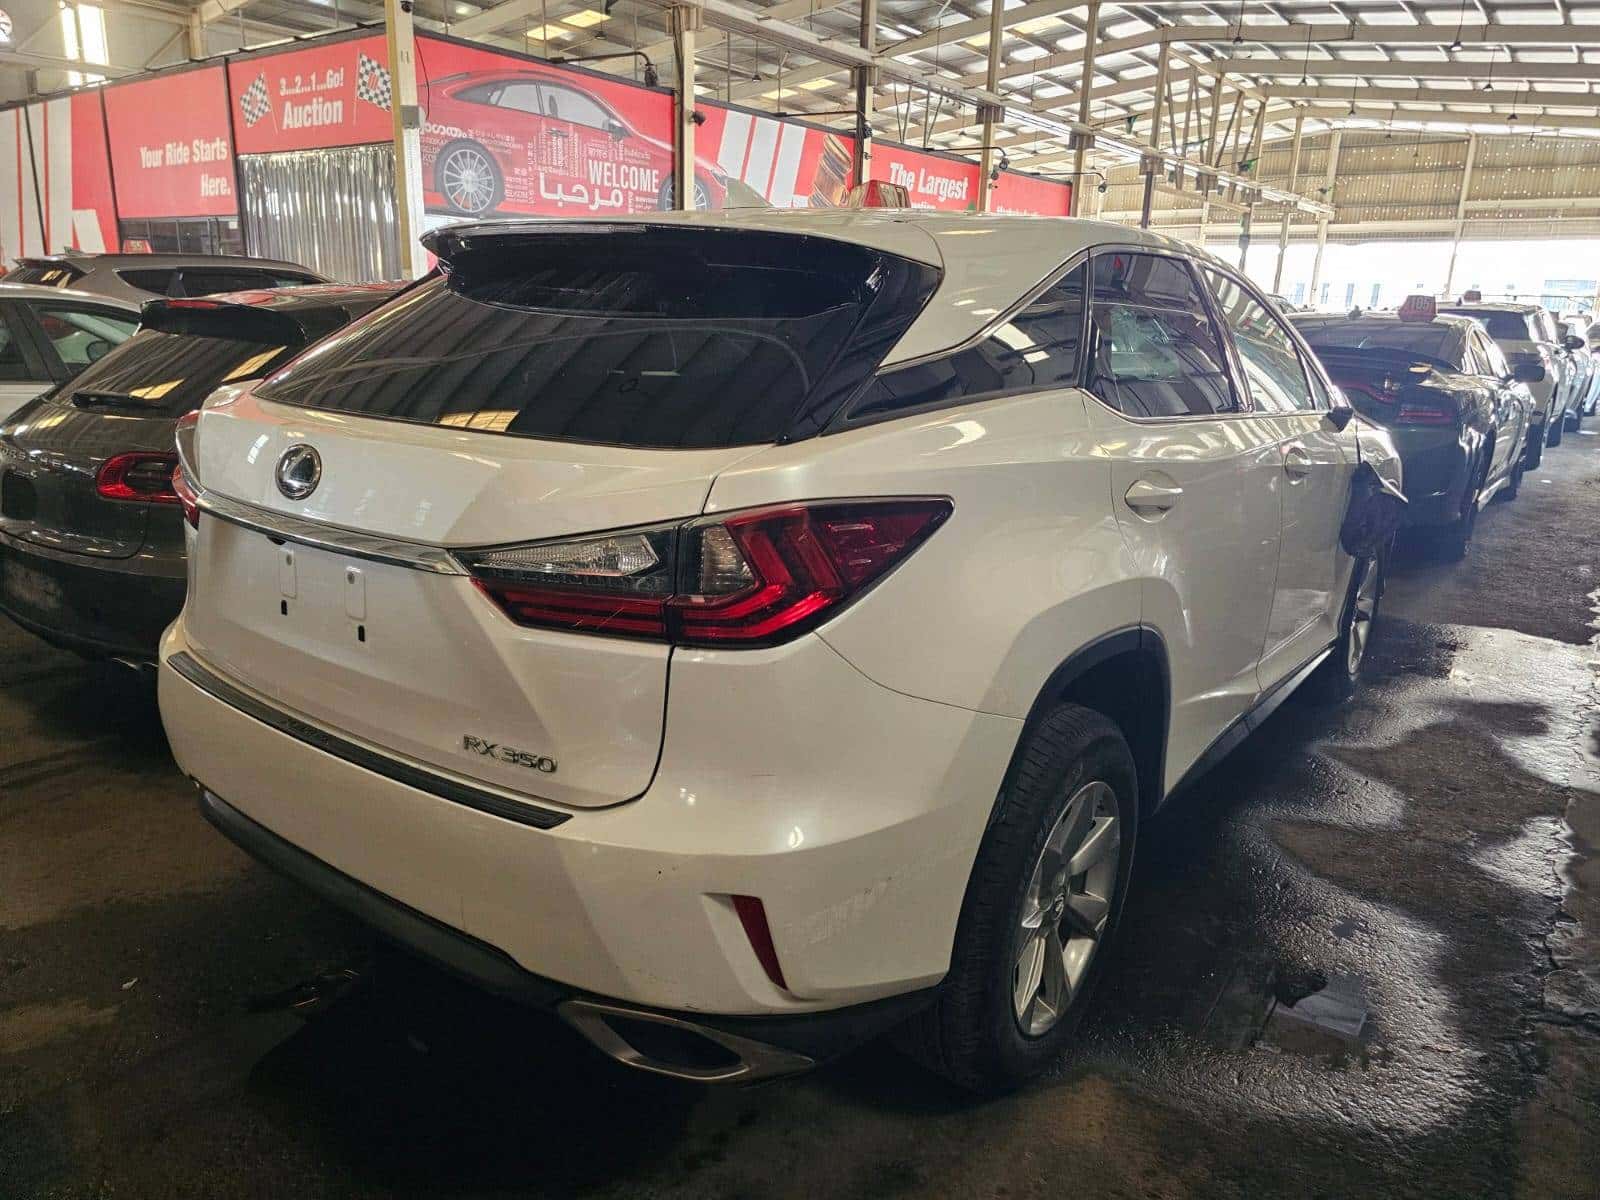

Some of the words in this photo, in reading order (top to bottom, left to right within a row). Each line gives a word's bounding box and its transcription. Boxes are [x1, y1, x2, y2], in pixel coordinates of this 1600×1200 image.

[282, 96, 343, 130] Auction
[140, 146, 163, 169] Your
[165, 141, 190, 166] Ride
[192, 136, 228, 162] Starts
[200, 173, 231, 197] Here.
[539, 171, 624, 211] مرحبا
[588, 159, 660, 193] WELCOME
[889, 162, 914, 192] The
[917, 168, 969, 202] Largest
